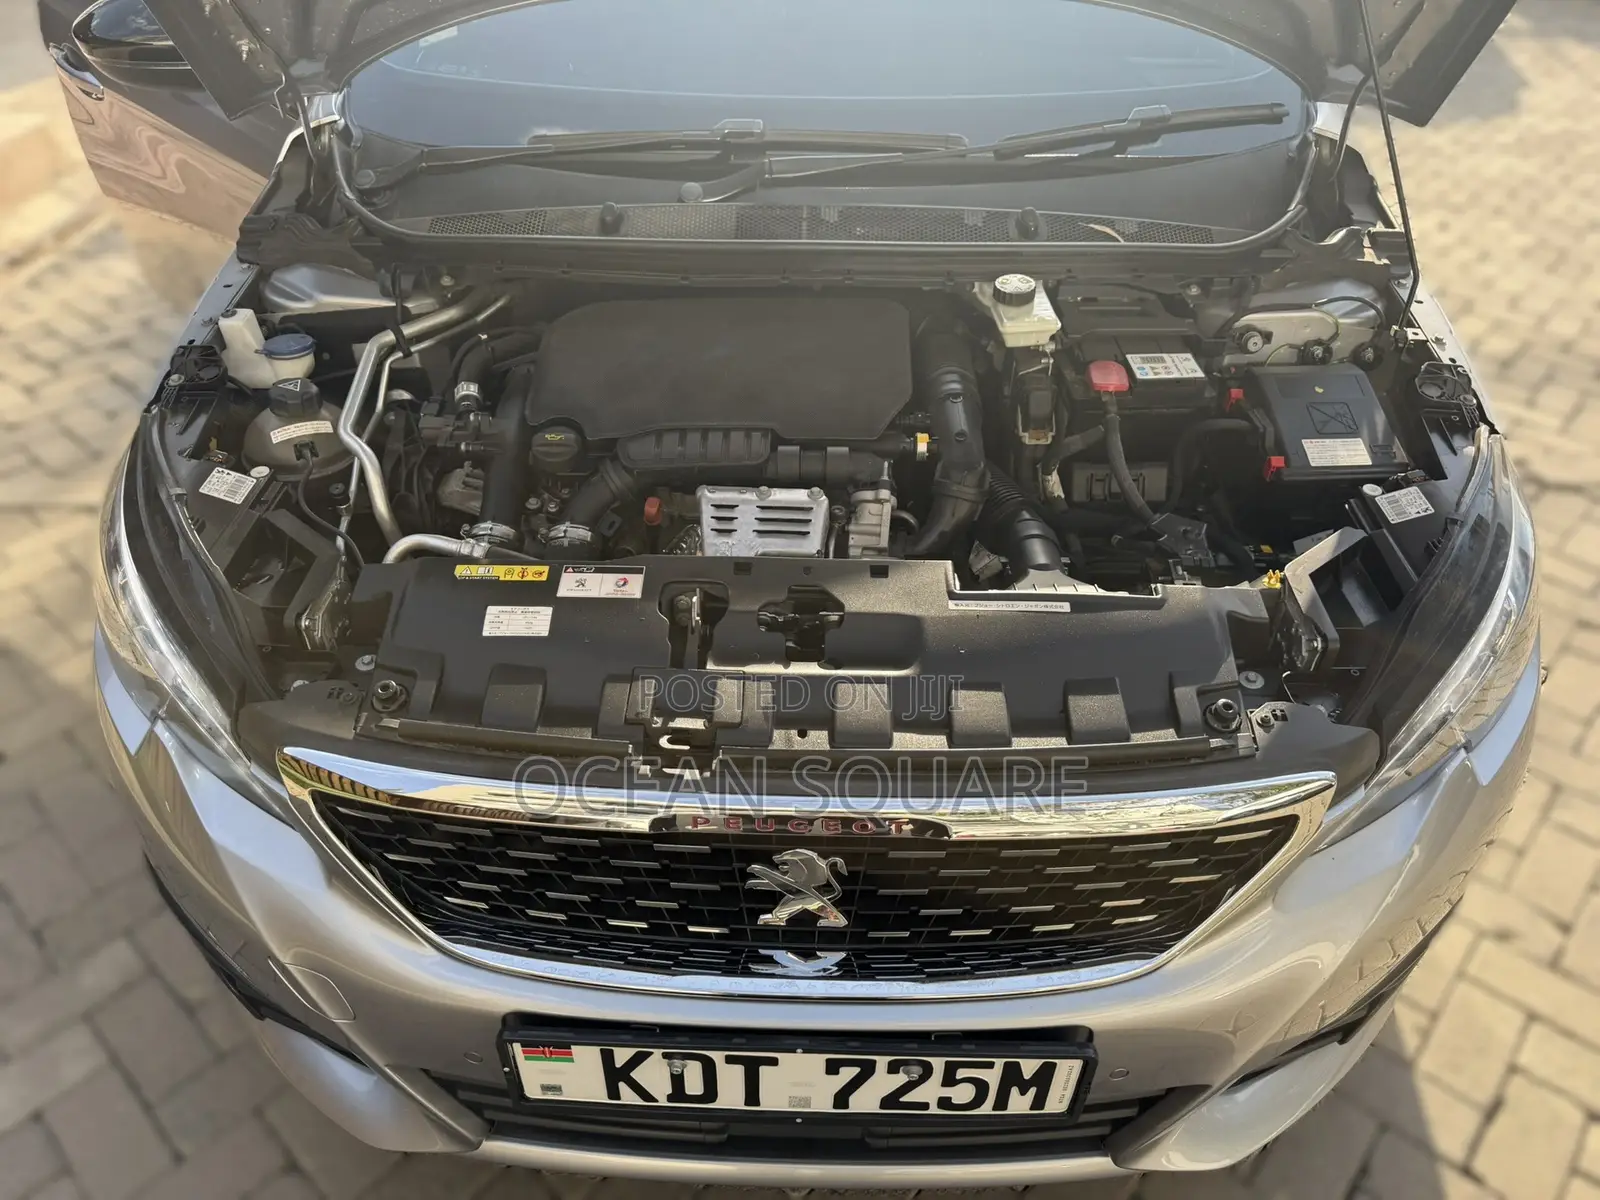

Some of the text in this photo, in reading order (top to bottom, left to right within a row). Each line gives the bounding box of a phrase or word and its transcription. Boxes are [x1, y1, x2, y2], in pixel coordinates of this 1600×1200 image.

[690, 815, 909, 835] PEUGEOT
[600, 1048, 779, 1106] KDT
[825, 1058, 1057, 1111] 725M
